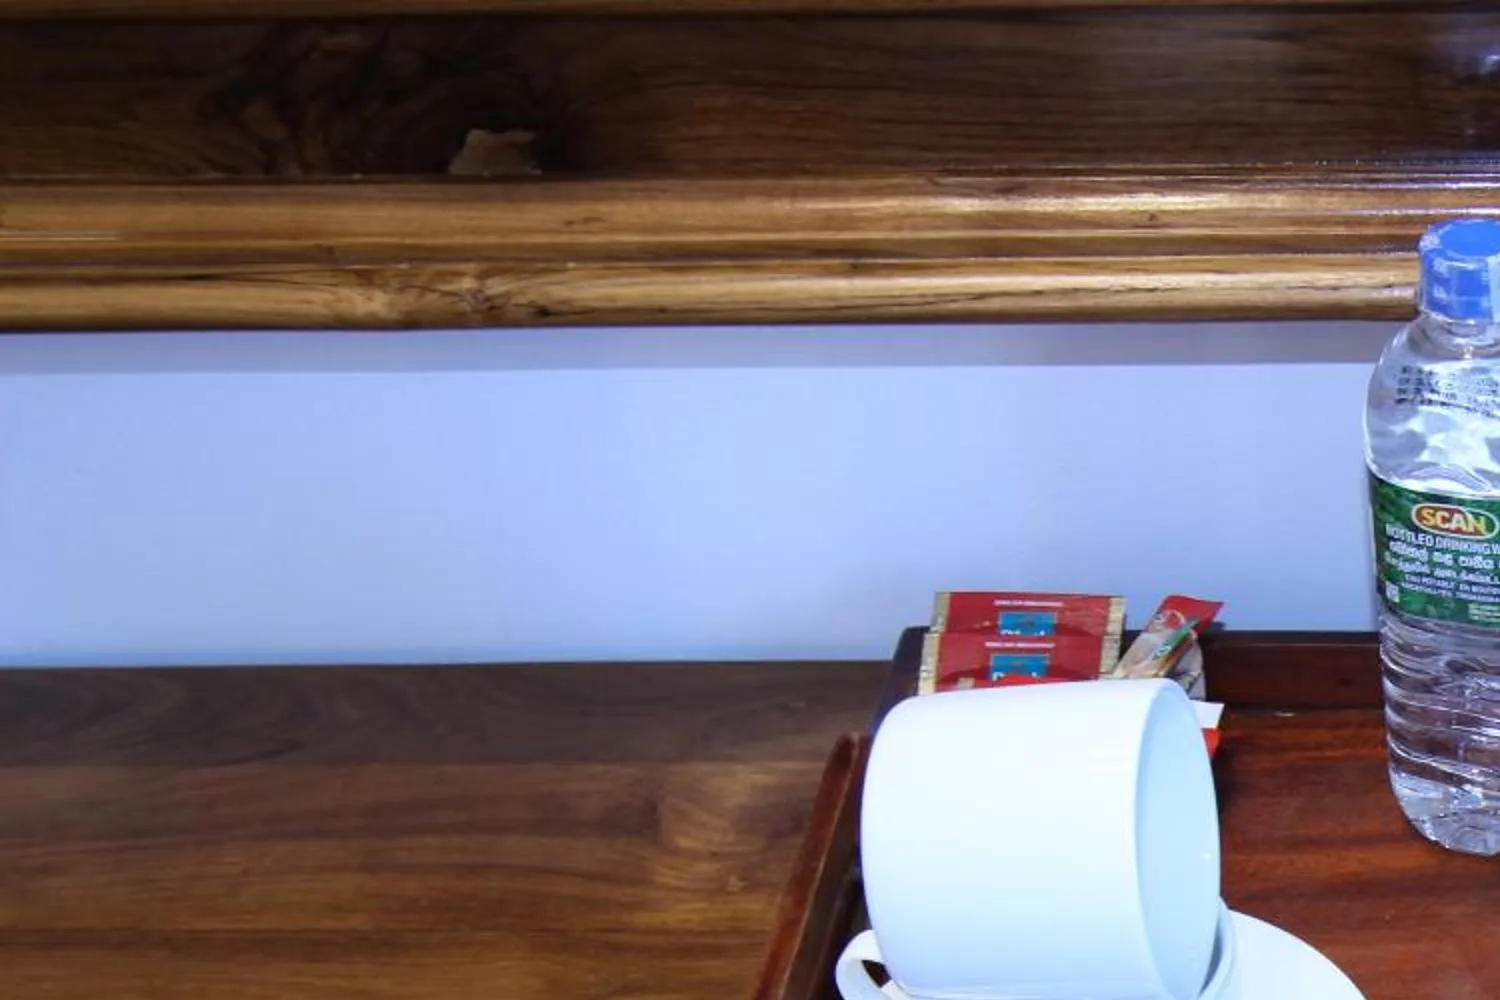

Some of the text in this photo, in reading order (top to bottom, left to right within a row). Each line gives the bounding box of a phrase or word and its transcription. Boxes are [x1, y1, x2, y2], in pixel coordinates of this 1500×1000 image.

[1420, 507, 1489, 535] SCAN
[1385, 523, 1434, 547] BOTTLED
[1435, 536, 1490, 555] DRINKING
